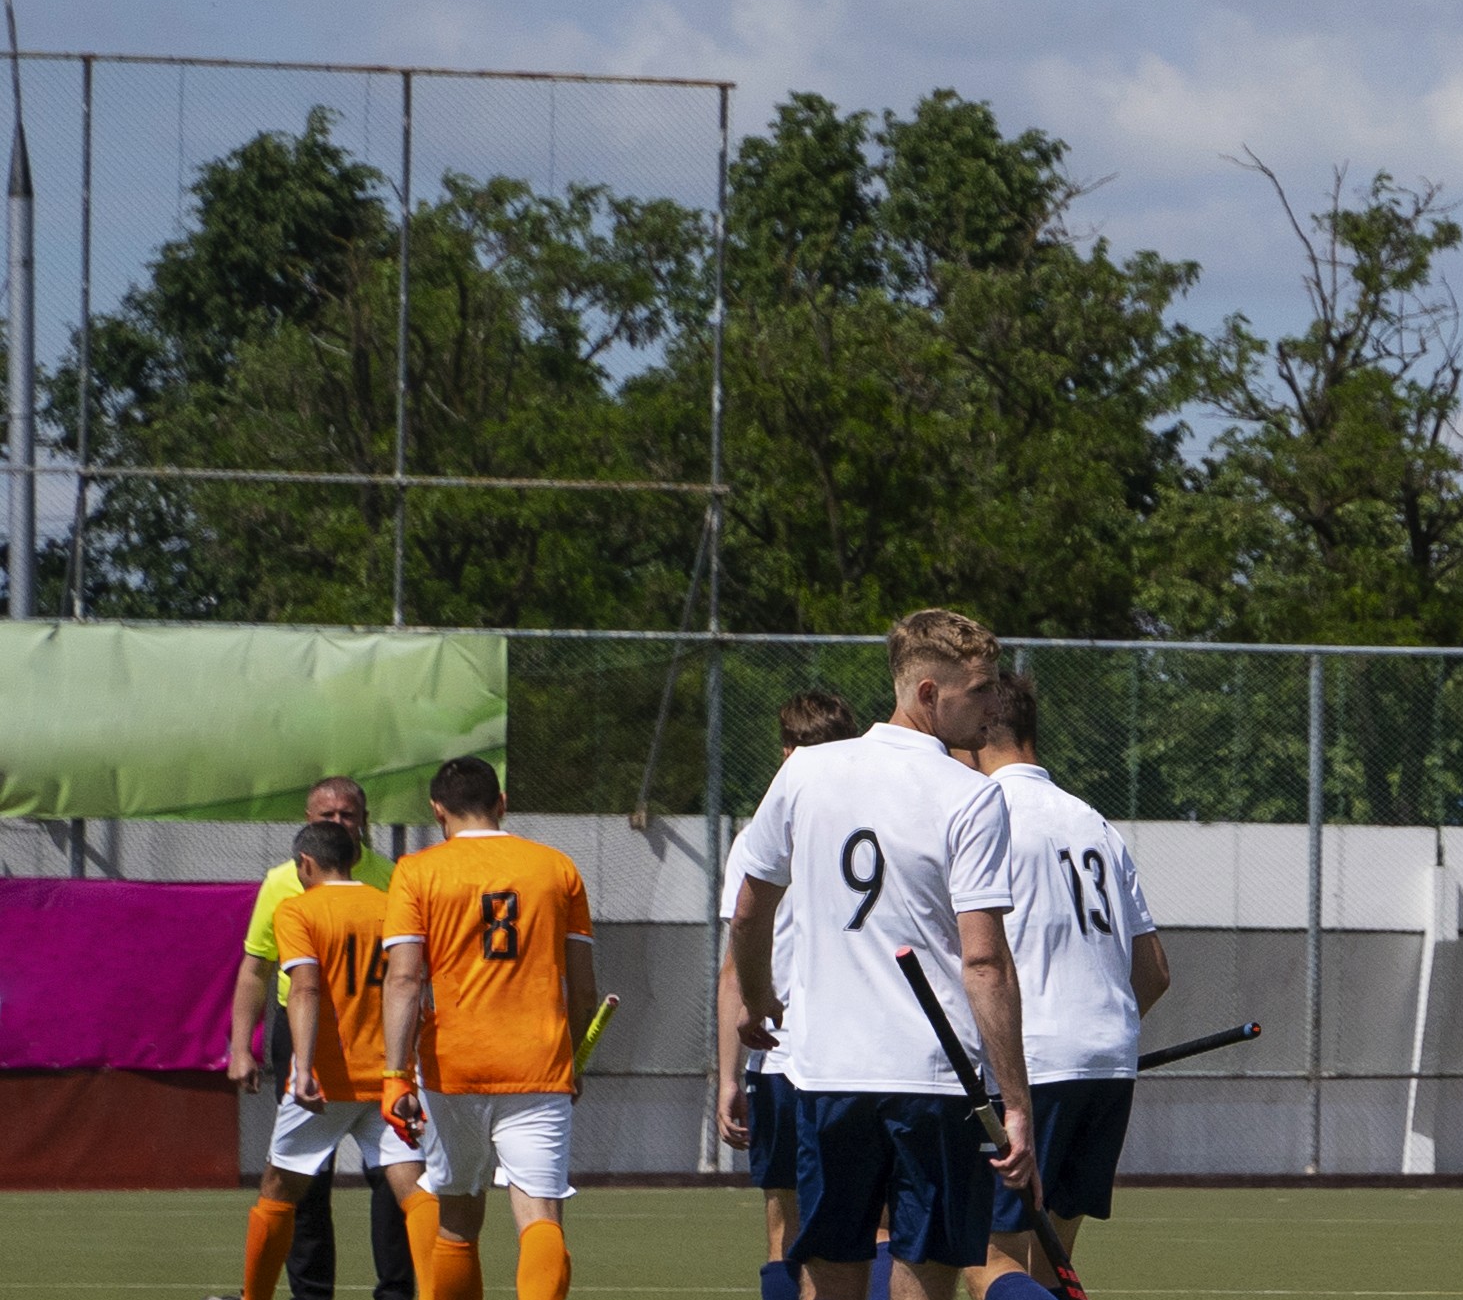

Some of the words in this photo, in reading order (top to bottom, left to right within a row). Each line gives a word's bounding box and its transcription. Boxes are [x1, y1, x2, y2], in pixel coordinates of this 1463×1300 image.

[840, 827, 886, 931] 9
[1058, 847, 1113, 936] 13
[481, 891, 519, 962] 8
